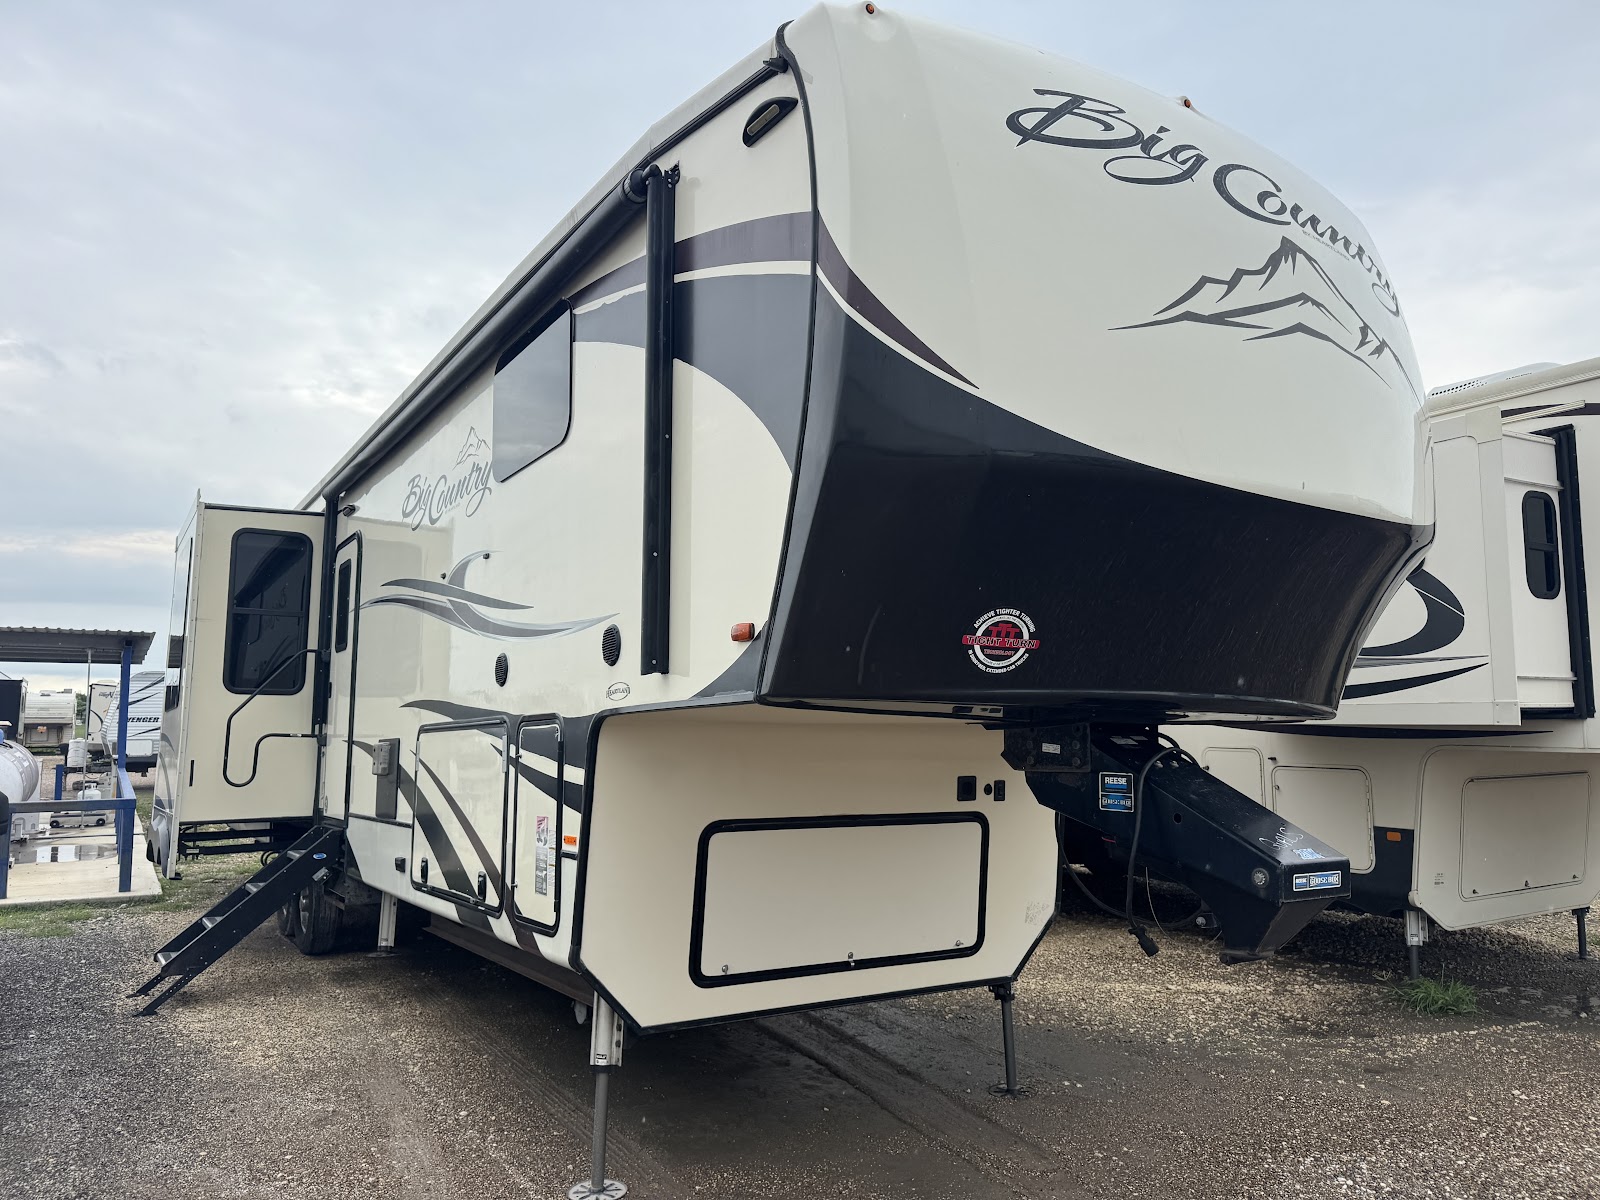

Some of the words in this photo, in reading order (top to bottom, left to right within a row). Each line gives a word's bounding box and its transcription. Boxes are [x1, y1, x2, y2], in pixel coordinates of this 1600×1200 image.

[1006, 88, 1209, 186] Big
[1212, 163, 1400, 318] Country
[401, 473, 431, 531] Big
[429, 461, 492, 525] Country
[966, 635, 1002, 647] TIGHT
[1004, 638, 1037, 649] TURN
[973, 610, 996, 629] ACHIEVE
[995, 608, 1021, 617] TIGHTER
[1019, 612, 1036, 633] TURNING
